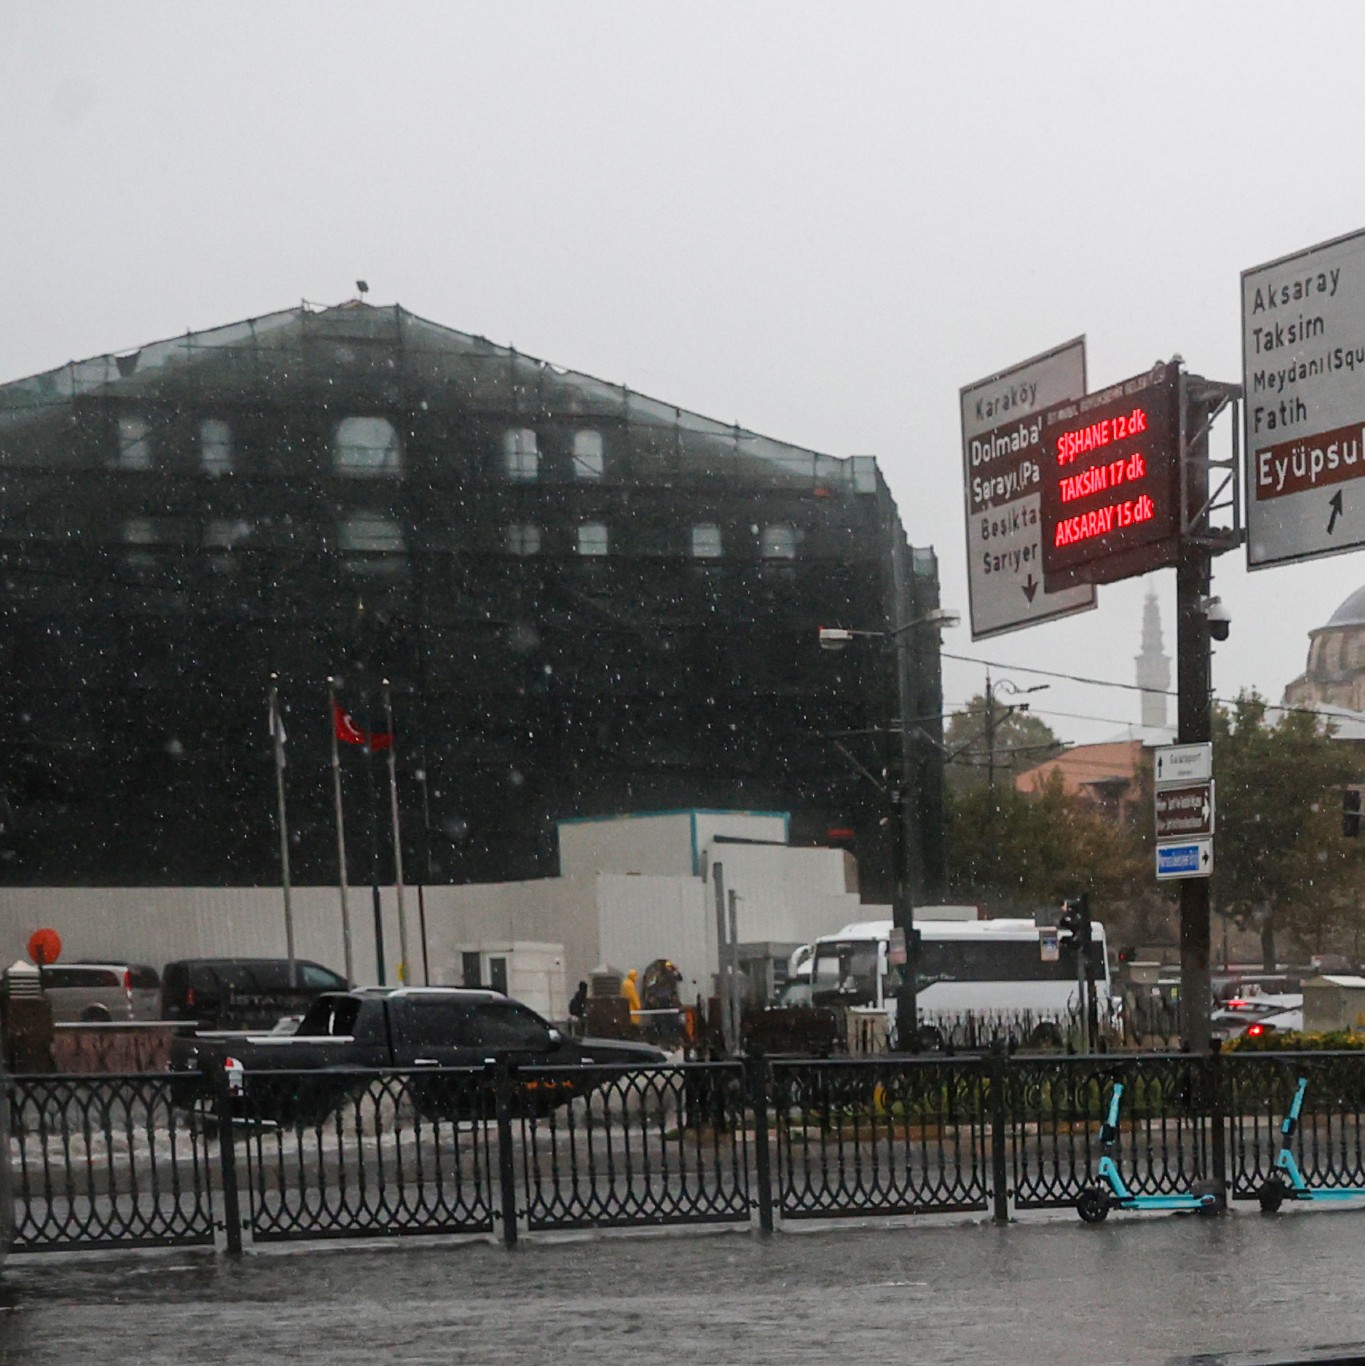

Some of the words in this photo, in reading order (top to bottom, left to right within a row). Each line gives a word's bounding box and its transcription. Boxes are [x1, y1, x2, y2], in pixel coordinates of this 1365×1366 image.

[1252, 268, 1340, 315] Aksaray
[1253, 315, 1324, 354] Taksim
[976, 383, 1037, 420] Karaköy
[1254, 397, 1307, 434] Fatih
[1112, 416, 1126, 441] 12
[1128, 409, 1147, 435] dk
[1059, 466, 1107, 503] TAKSİM
[1110, 460, 1125, 487] 17
[1126, 453, 1146, 481] dk
[1055, 505, 1114, 547] AKSARAY
[1117, 501, 1132, 527] 15
[1134, 495, 1153, 523] dk
[983, 543, 1037, 574] Sarıyer
